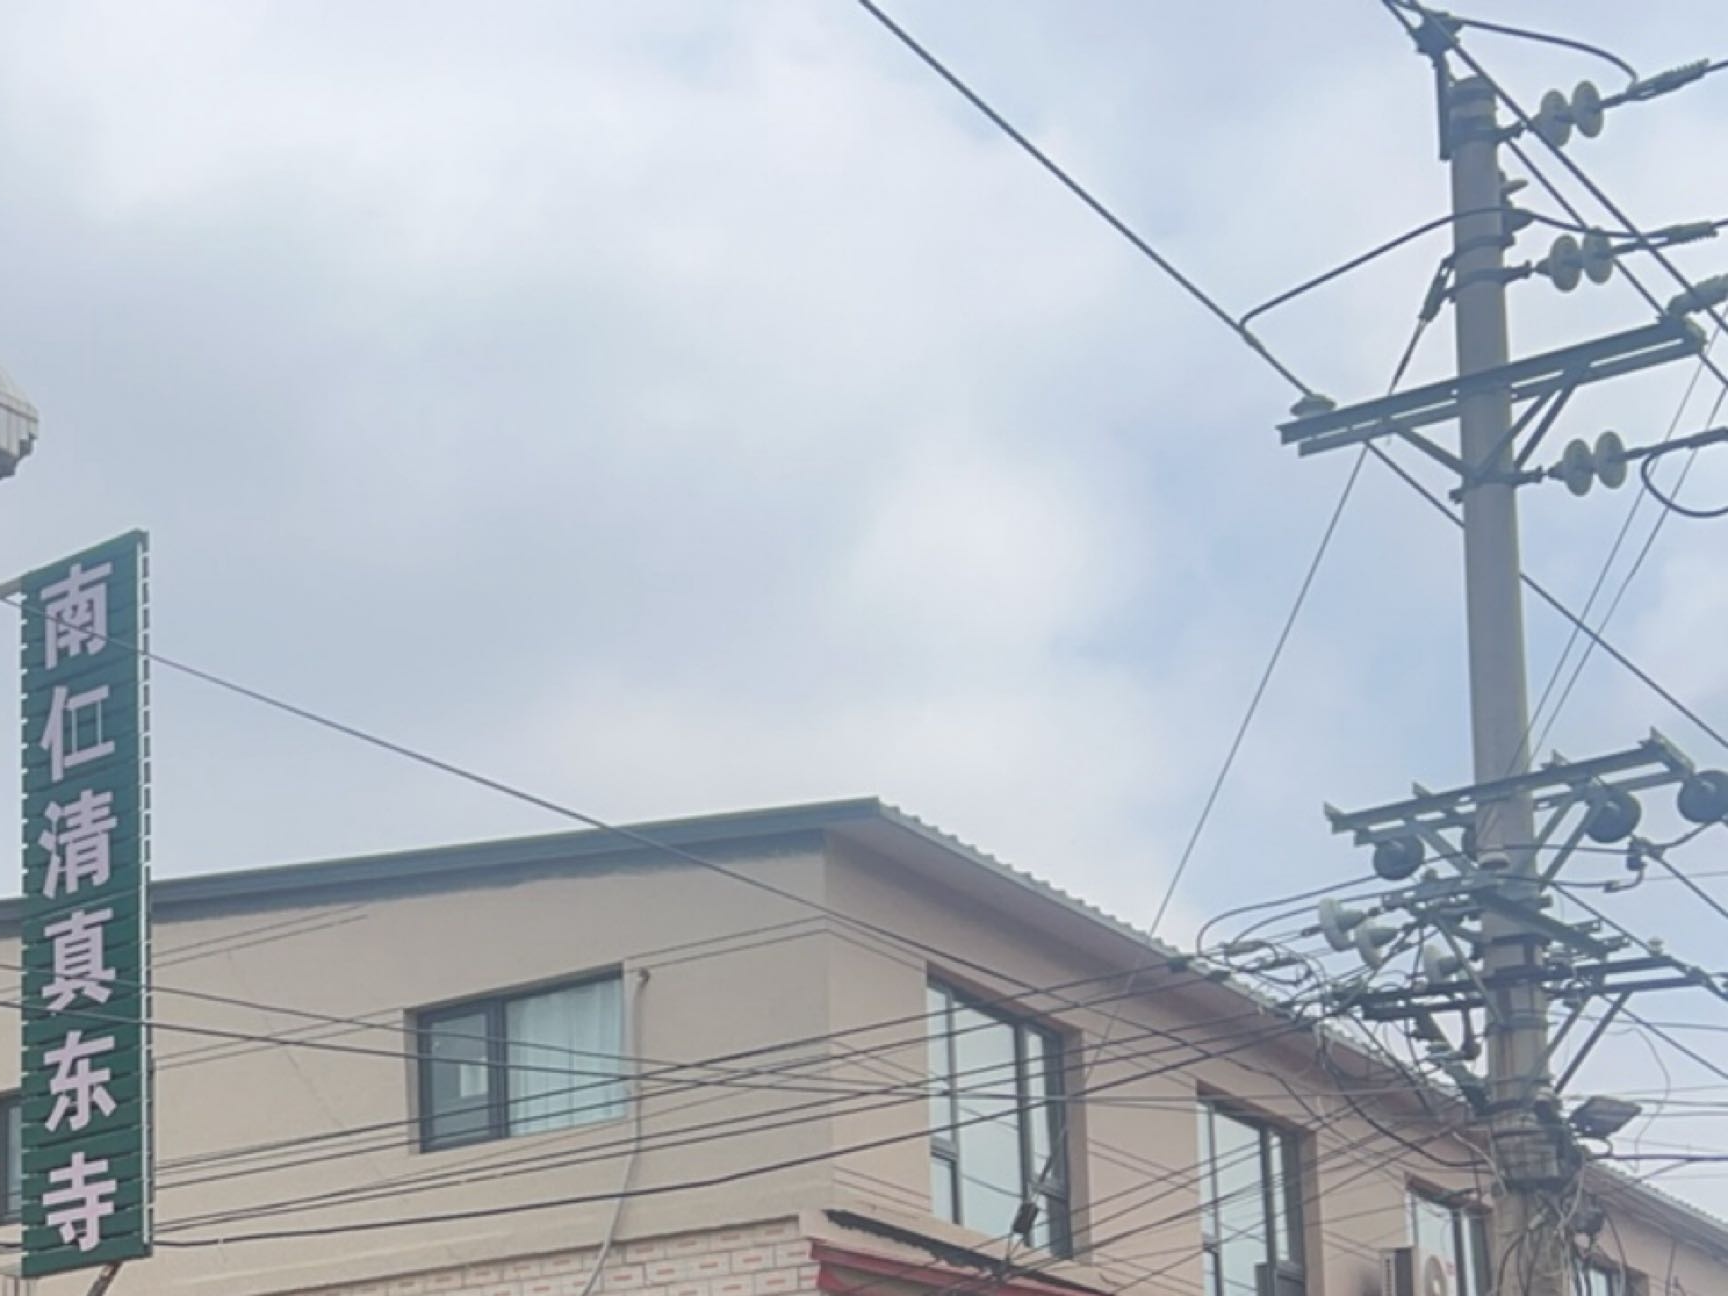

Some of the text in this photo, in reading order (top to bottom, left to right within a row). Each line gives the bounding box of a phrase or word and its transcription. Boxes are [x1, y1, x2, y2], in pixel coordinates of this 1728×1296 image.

[39, 560, 118, 1253] 南仁清真东寺
